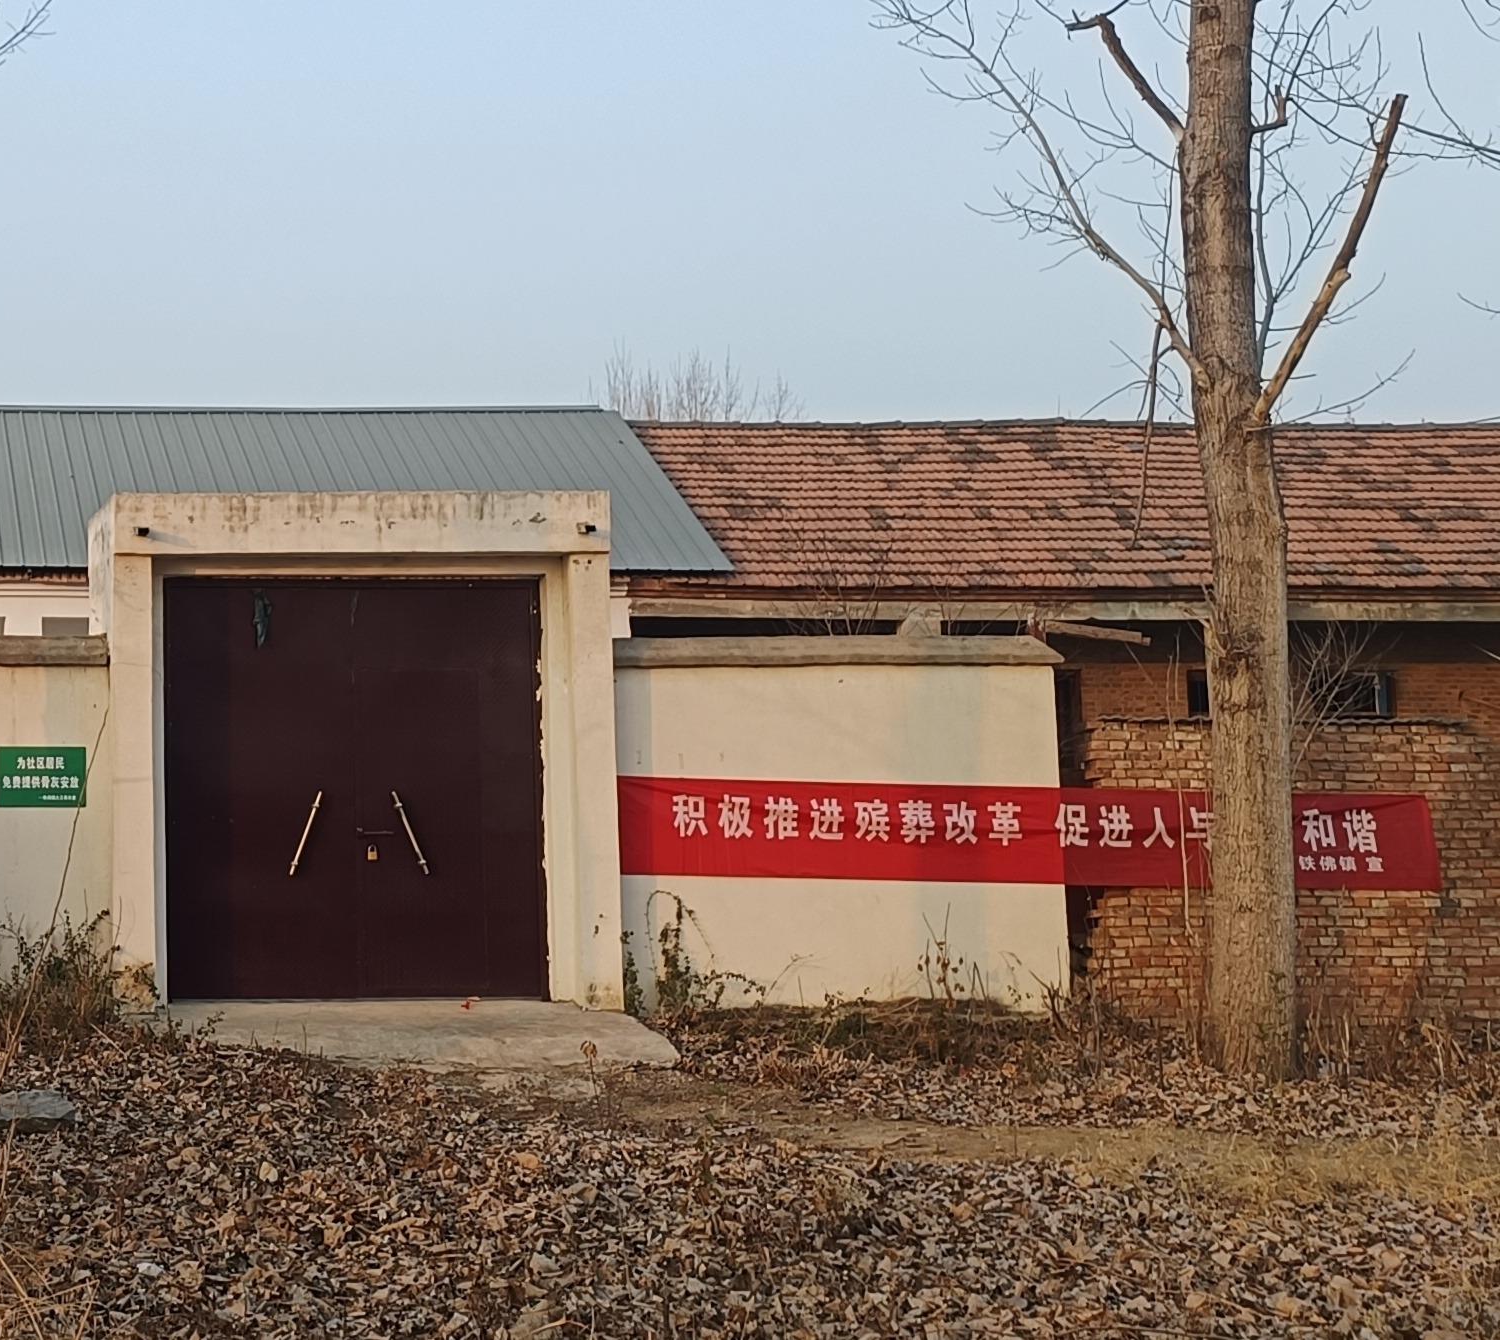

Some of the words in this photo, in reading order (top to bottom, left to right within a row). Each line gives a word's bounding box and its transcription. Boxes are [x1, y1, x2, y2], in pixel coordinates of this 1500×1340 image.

[17, 756, 64, 769] 为社区居民
[3, 776, 79, 788] 免费提供骨灰安放
[672, 793, 1023, 846] 积极推进殡葬改革
[1054, 803, 1378, 853] 促进人与和谐
[1299, 855, 1357, 871] 铁佛镇
[1365, 856, 1384, 872] 宣
